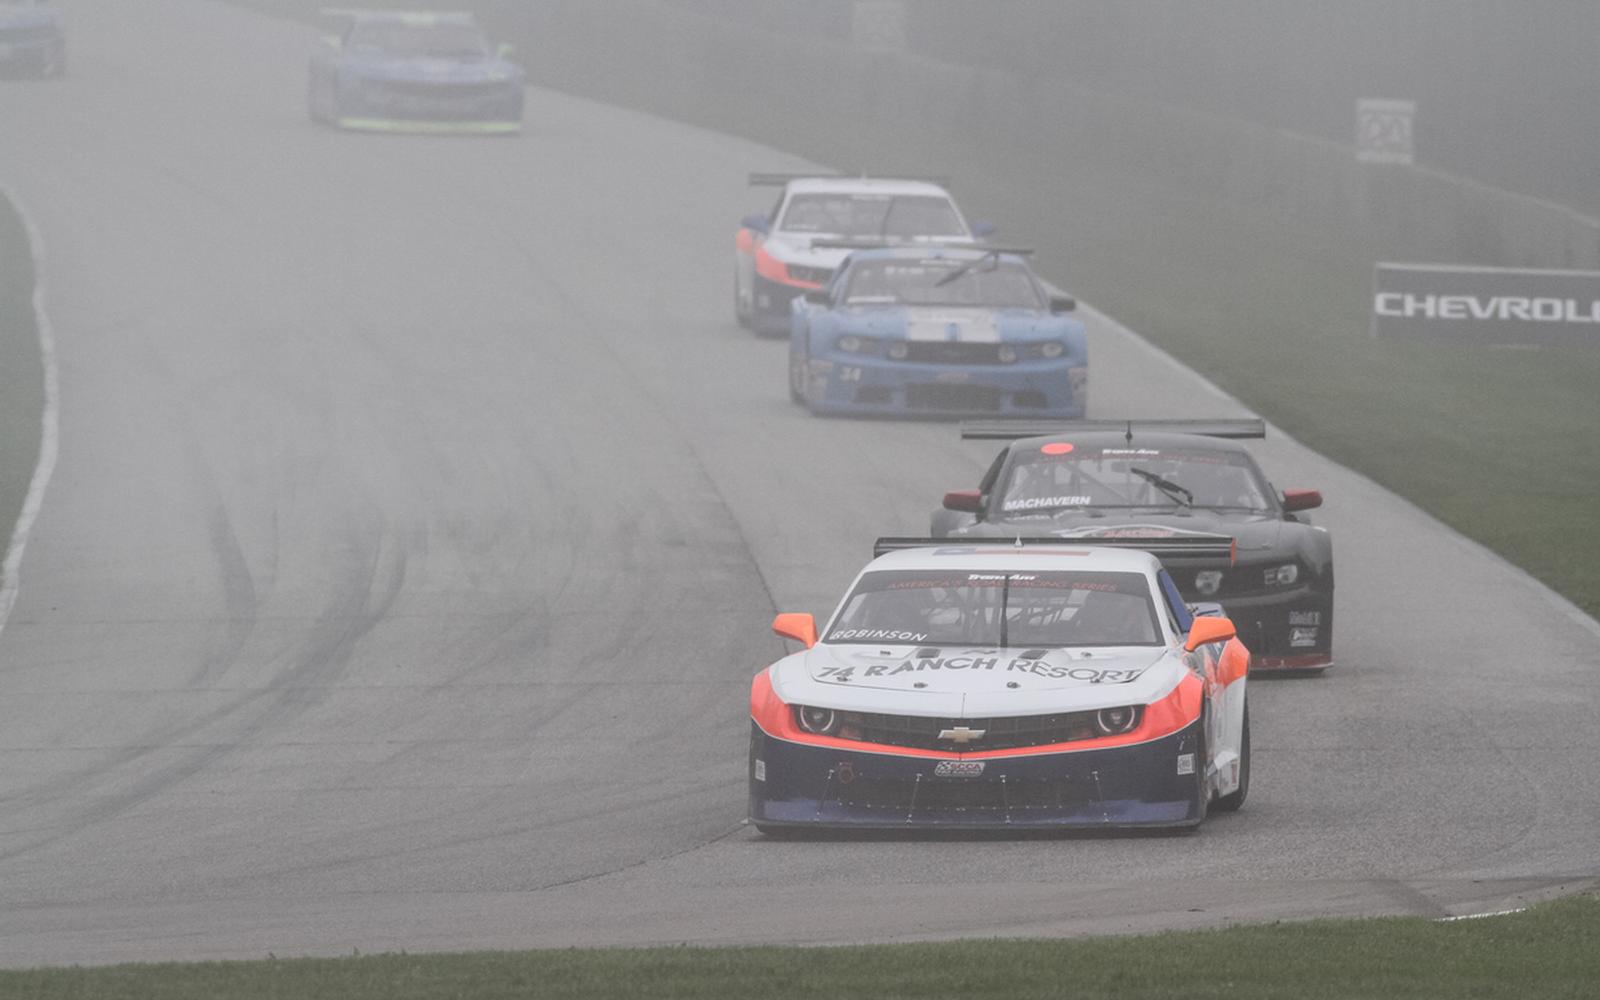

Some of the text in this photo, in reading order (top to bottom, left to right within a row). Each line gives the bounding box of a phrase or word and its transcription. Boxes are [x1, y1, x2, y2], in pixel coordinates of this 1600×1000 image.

[1004, 496, 1091, 510] MACHAVERN
[829, 629, 928, 642] ROBINSON
[821, 656, 1141, 682] 74 RANCH RESORT
